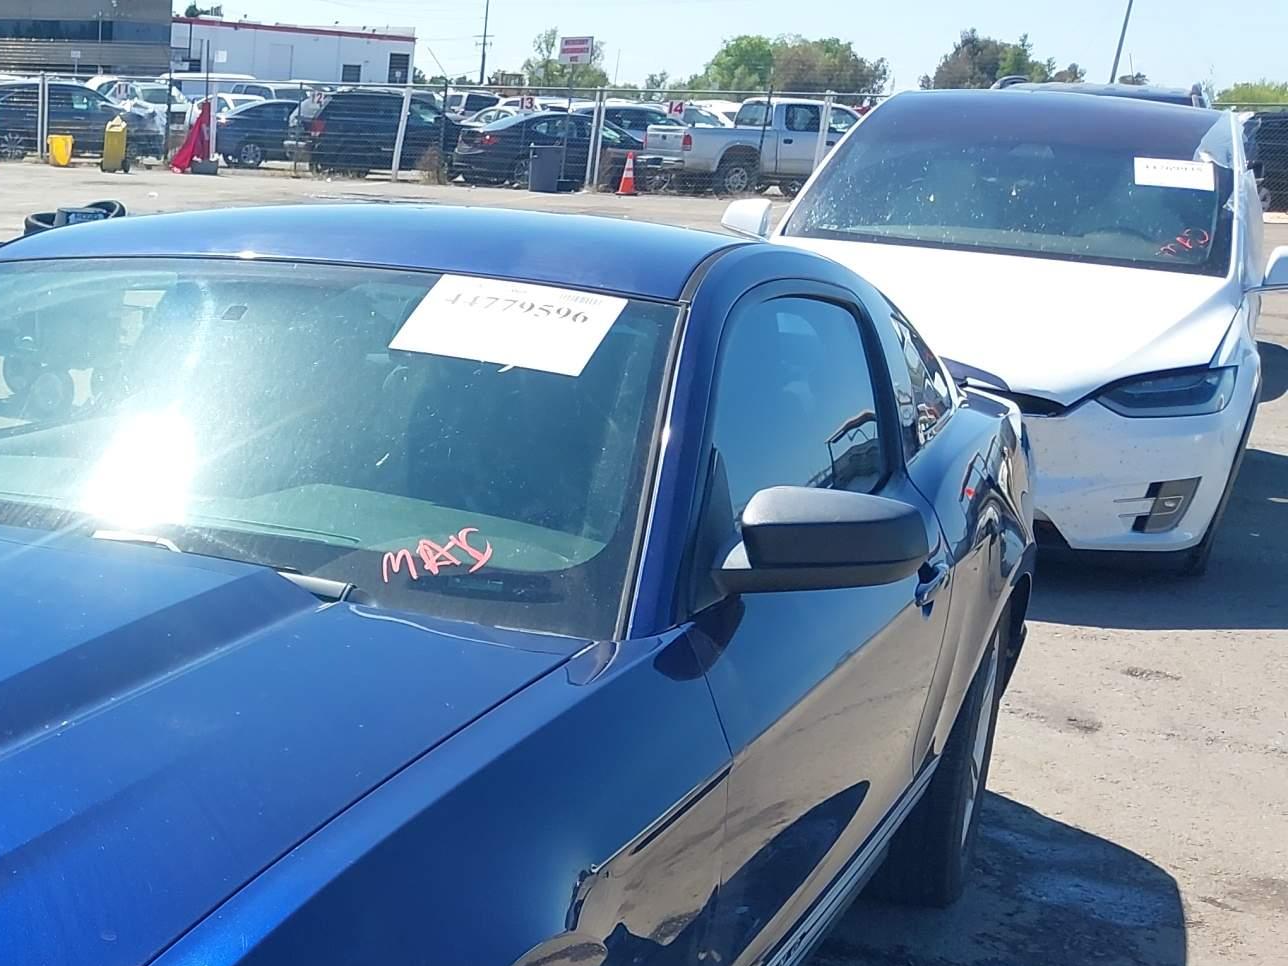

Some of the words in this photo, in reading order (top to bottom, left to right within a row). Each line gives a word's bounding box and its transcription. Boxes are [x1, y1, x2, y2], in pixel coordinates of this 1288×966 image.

[520, 97, 534, 110] 13
[668, 101, 683, 114] 14
[444, 292, 590, 323] 44779596
